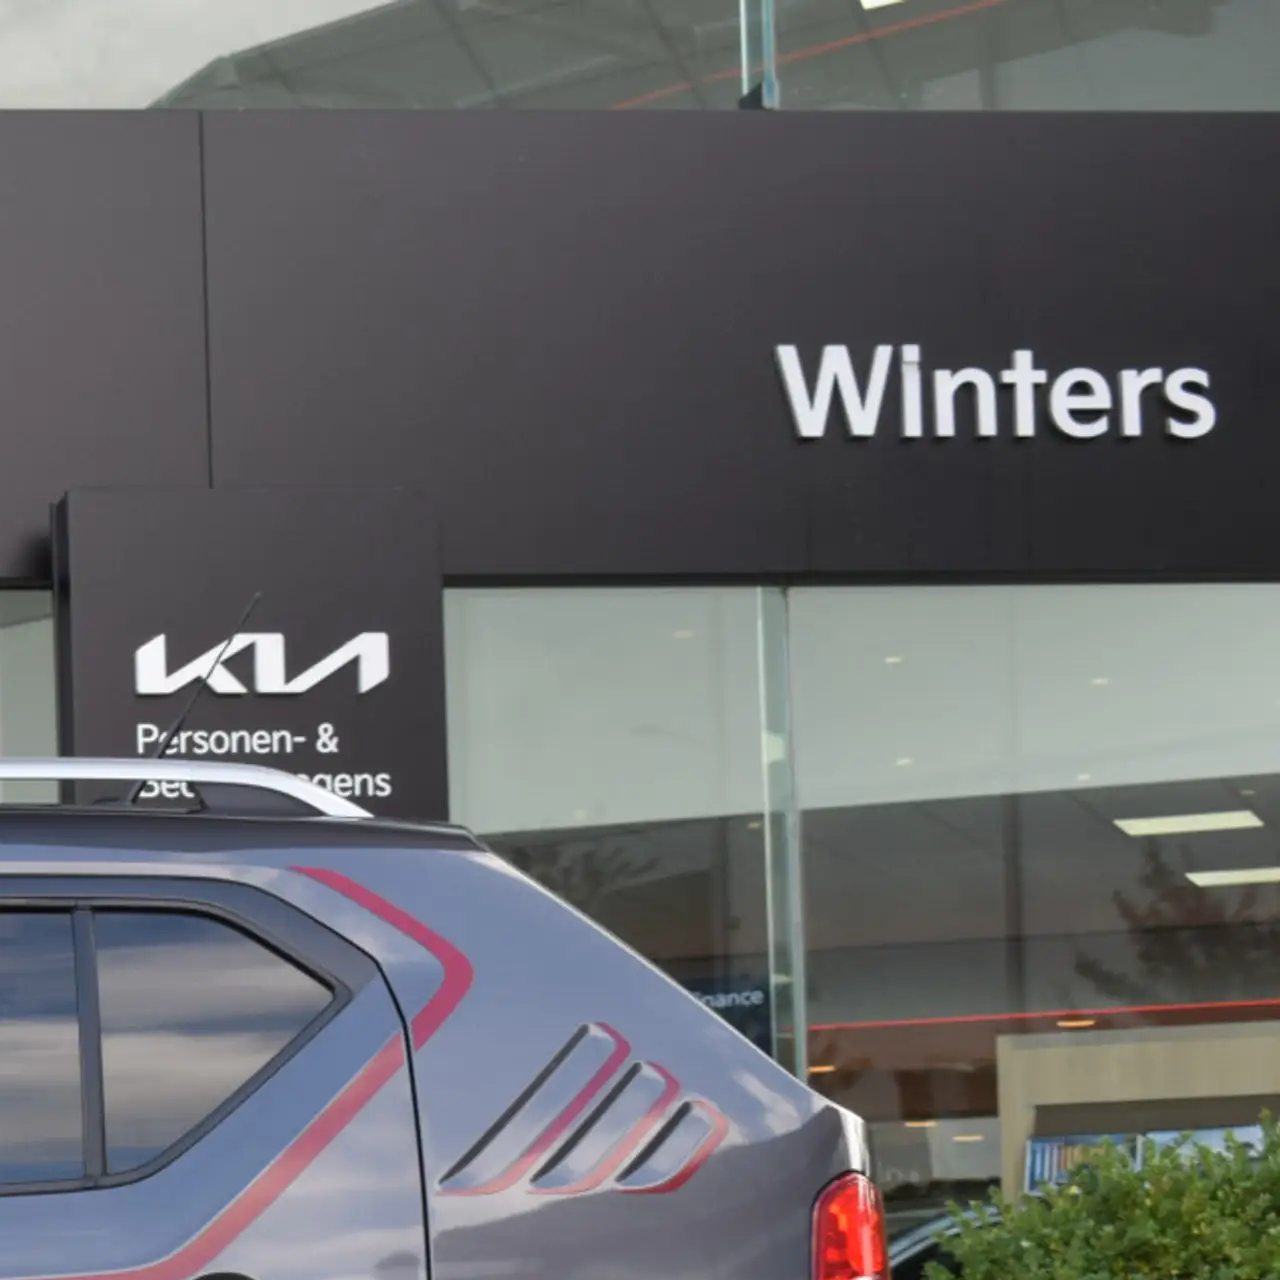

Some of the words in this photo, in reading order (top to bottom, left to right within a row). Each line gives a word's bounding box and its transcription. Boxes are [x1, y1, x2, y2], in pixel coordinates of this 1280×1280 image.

[776, 344, 1216, 438] Winters
[134, 632, 390, 694] KIA
[136, 723, 307, 755] Personen-
[315, 722, 339, 754] &
